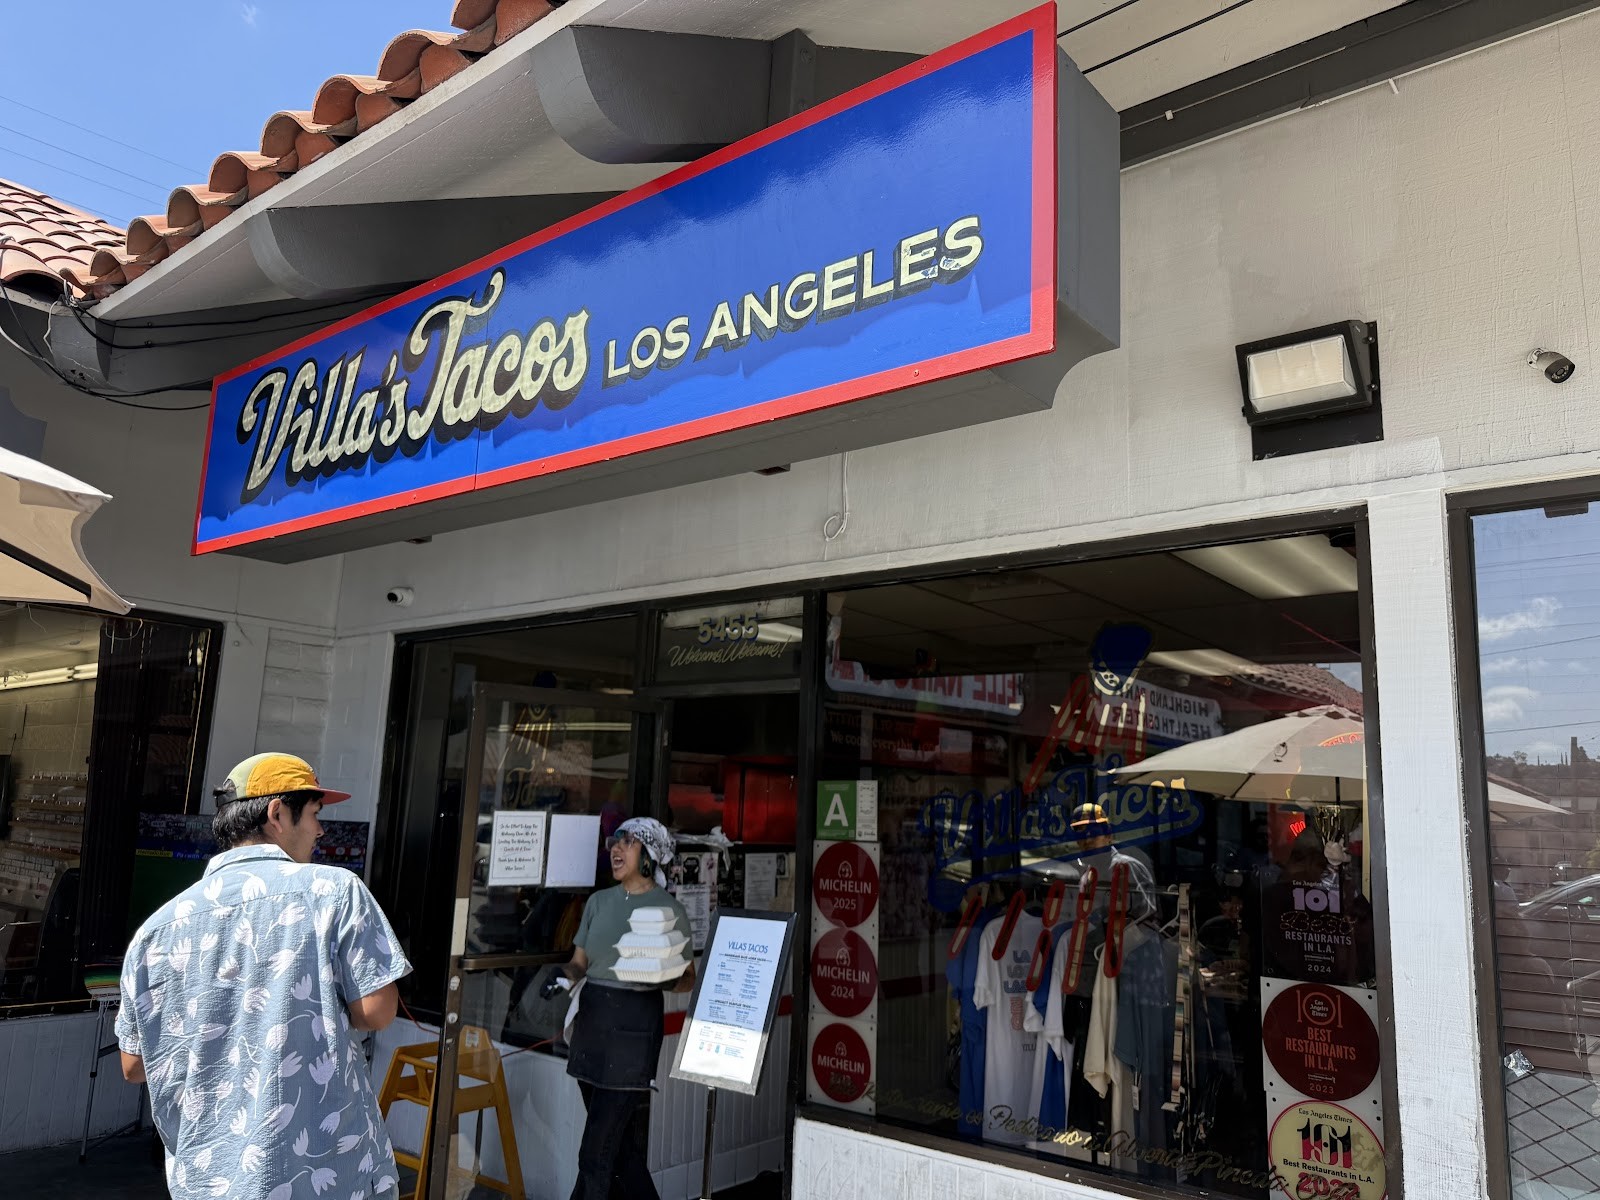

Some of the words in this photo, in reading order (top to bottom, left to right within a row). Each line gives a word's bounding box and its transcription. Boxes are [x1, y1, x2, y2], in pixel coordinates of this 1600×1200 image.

[240, 350, 411, 492] Villa's
[405, 268, 592, 443] Tacos
[604, 313, 692, 381] LOS
[699, 214, 986, 351] ANGELES
[698, 612, 760, 644] 5455
[823, 792, 849, 827] A
[819, 878, 872, 895] MICHELIN
[833, 897, 857, 911] 2025
[1292, 887, 1341, 914] 101
[1284, 930, 1352, 946] RESTAURANTS
[1303, 941, 1314, 952] IN
[1317, 943, 1335, 954] L.A.
[816, 963, 870, 984] MICHELIN
[1307, 963, 1332, 973] 2024
[830, 984, 855, 1000] 2024
[1307, 1026, 1332, 1043] BEST
[1285, 1036, 1356, 1061] RESTAURANTS
[816, 1053, 865, 1075] MICHELIN
[1304, 1054, 1315, 1069] IN
[1317, 1055, 1338, 1072] L.A.
[1309, 1082, 1334, 1094] 2023
[1298, 1107, 1309, 1116] Los
[1310, 1109, 1333, 1120] Angeles
[1333, 1114, 1353, 1124] Times
[1282, 1158, 1300, 1168] Best
[1301, 1162, 1348, 1178] Restaurants
[1349, 1172, 1357, 1180] in
[1358, 1174, 1375, 1184] L.A.
